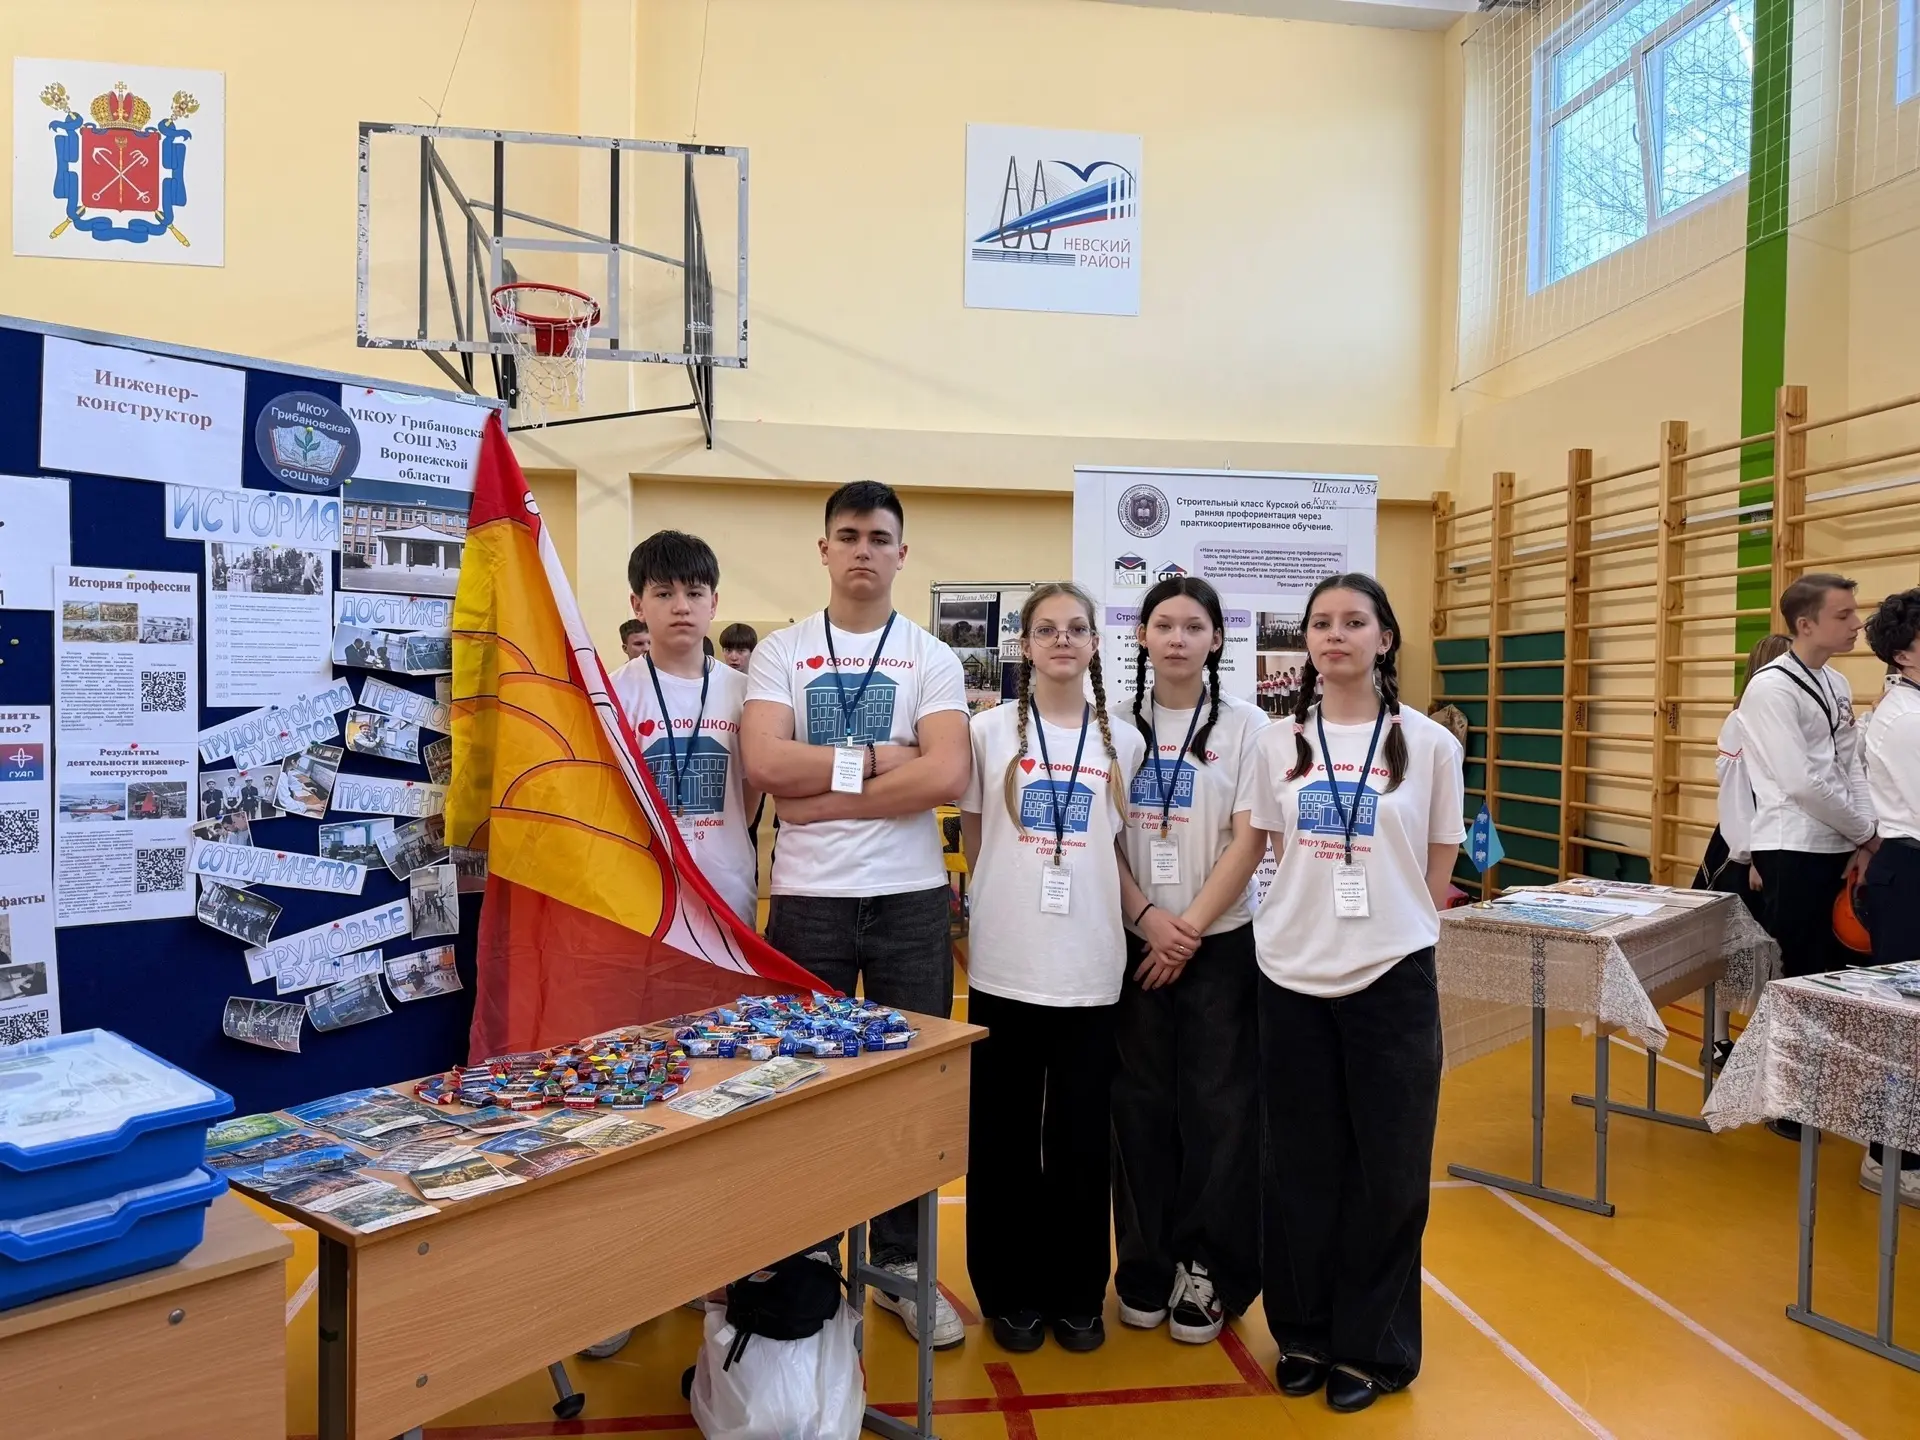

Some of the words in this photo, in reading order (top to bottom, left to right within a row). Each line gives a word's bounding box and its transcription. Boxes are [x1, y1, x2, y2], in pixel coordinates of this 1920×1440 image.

[1063, 237, 1131, 253] НЕВСКИЙ
[1080, 253, 1130, 269] РАЙОН
[94, 368, 199, 403] Инженер-
[76, 395, 213, 431] конструктор
[296, 401, 330, 418] МКОУ
[271, 406, 351, 435] Грибановская
[349, 407, 398, 426] МКОУ
[401, 415, 485, 439] Грибановска
[393, 432, 432, 448] СОШ
[435, 437, 457, 452] №3
[380, 447, 469, 470] Воронежской
[280, 468, 309, 483] СОШ
[310, 473, 330, 486] №3
[398, 469, 451, 484] области
[1312, 482, 1351, 494] Школа
[1352, 483, 1377, 495] №54
[1176, 497, 1239, 507] Строительный
[1240, 500, 1264, 508] класс
[1265, 500, 1299, 511] Курской
[173, 484, 340, 543] ИСТОРИЯ
[1194, 509, 1225, 518] ранняя
[1226, 510, 1297, 520] профориентация
[1298, 512, 1322, 521] через
[1180, 520, 1291, 530] практикоориентированное
[1292, 522, 1333, 532] обучение.
[68, 575, 123, 591] История
[126, 580, 191, 594] профессии
[340, 596, 453, 628] ДОСТИЖЕН
[796, 661, 804, 670] Я
[199, 685, 351, 760] ТРУДОУСТРОЙСТВО
[657, 718, 694, 731] СОЮ
[235, 715, 338, 770] СТУДЕНТОВ
[99, 749, 160, 758] Результаты
[66, 759, 139, 768] деятельности
[141, 759, 190, 768] инженер-
[9, 770, 34, 778] ГУАП
[90, 768, 168, 778] конструкторов
[1035, 847, 1054, 855] СОШ
[1314, 850, 1334, 860] СОШ
[197, 843, 358, 891] СОТРУДНИЧЕСТВО
[254, 906, 407, 977] ТРУДОВЫЕ
[278, 950, 382, 990] БУДНИ
